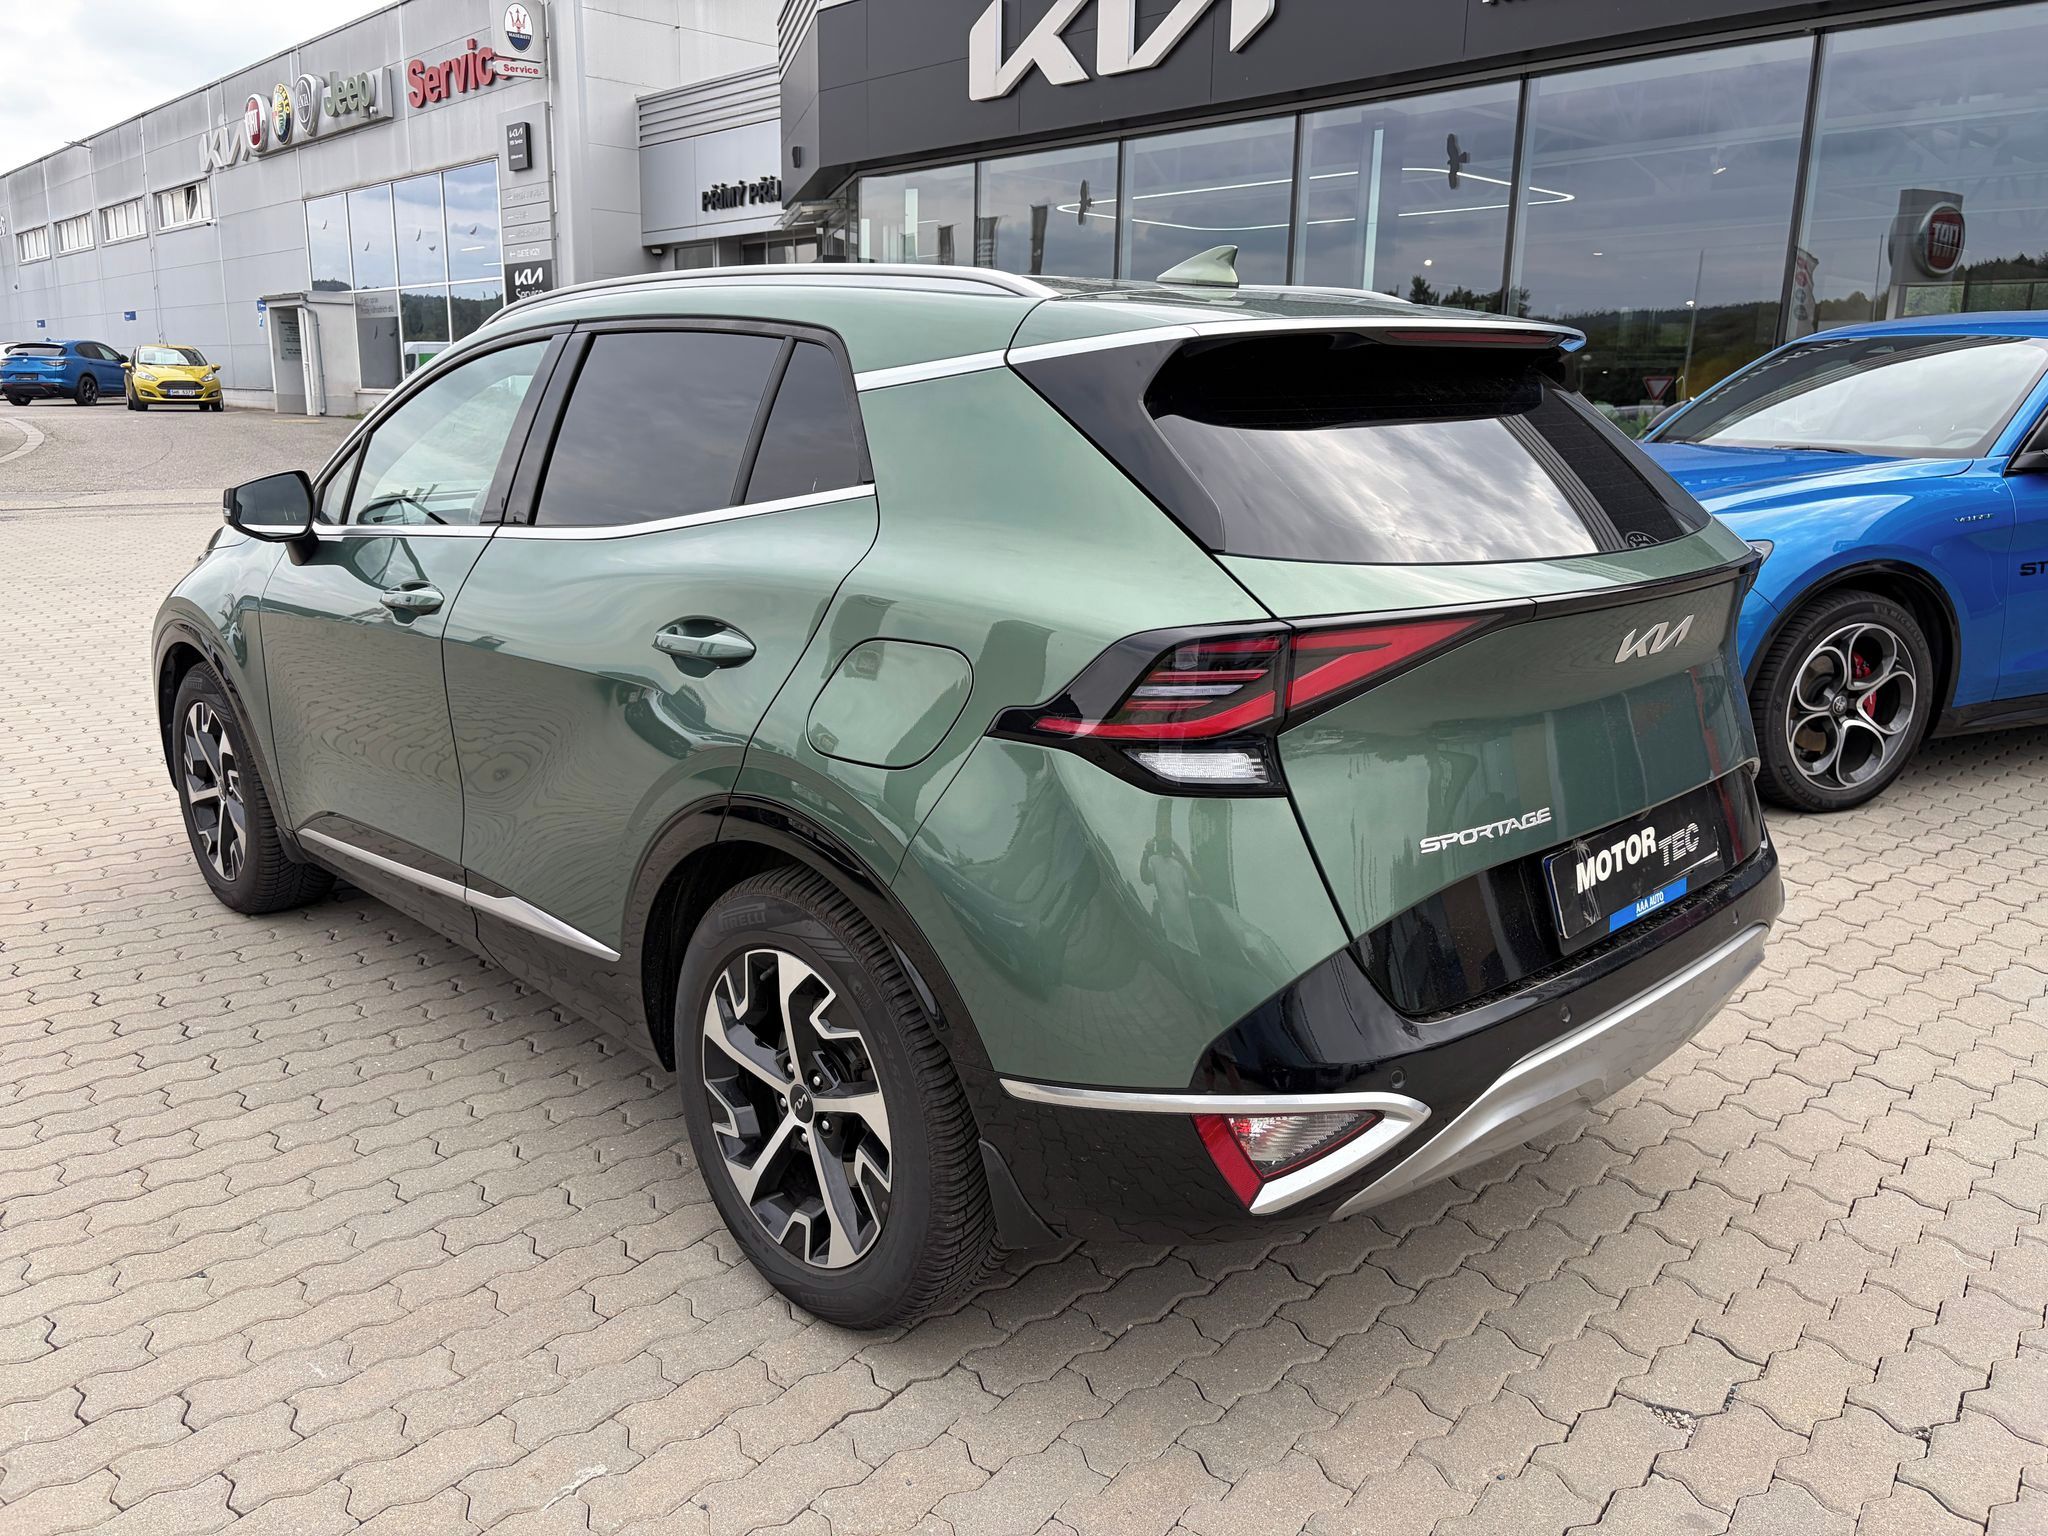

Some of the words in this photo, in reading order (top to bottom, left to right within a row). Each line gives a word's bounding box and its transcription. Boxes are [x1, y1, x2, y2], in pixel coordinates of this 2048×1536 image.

[408, 38, 512, 108] Servic
[503, 63, 539, 75] Service
[323, 71, 374, 118] Jeep
[200, 125, 250, 173] KIA
[509, 127, 523, 138] KIA
[514, 267, 544, 286] KIA
[1614, 614, 1695, 664] KIA
[1419, 807, 1552, 854] SPORTAGE
[1576, 826, 1657, 894] MOTOR
[1658, 822, 1700, 867] TEC
[721, 903, 767, 931] PIRELLI
[1636, 898, 1649, 914] AAA
[1650, 890, 1665, 907] AUTO
